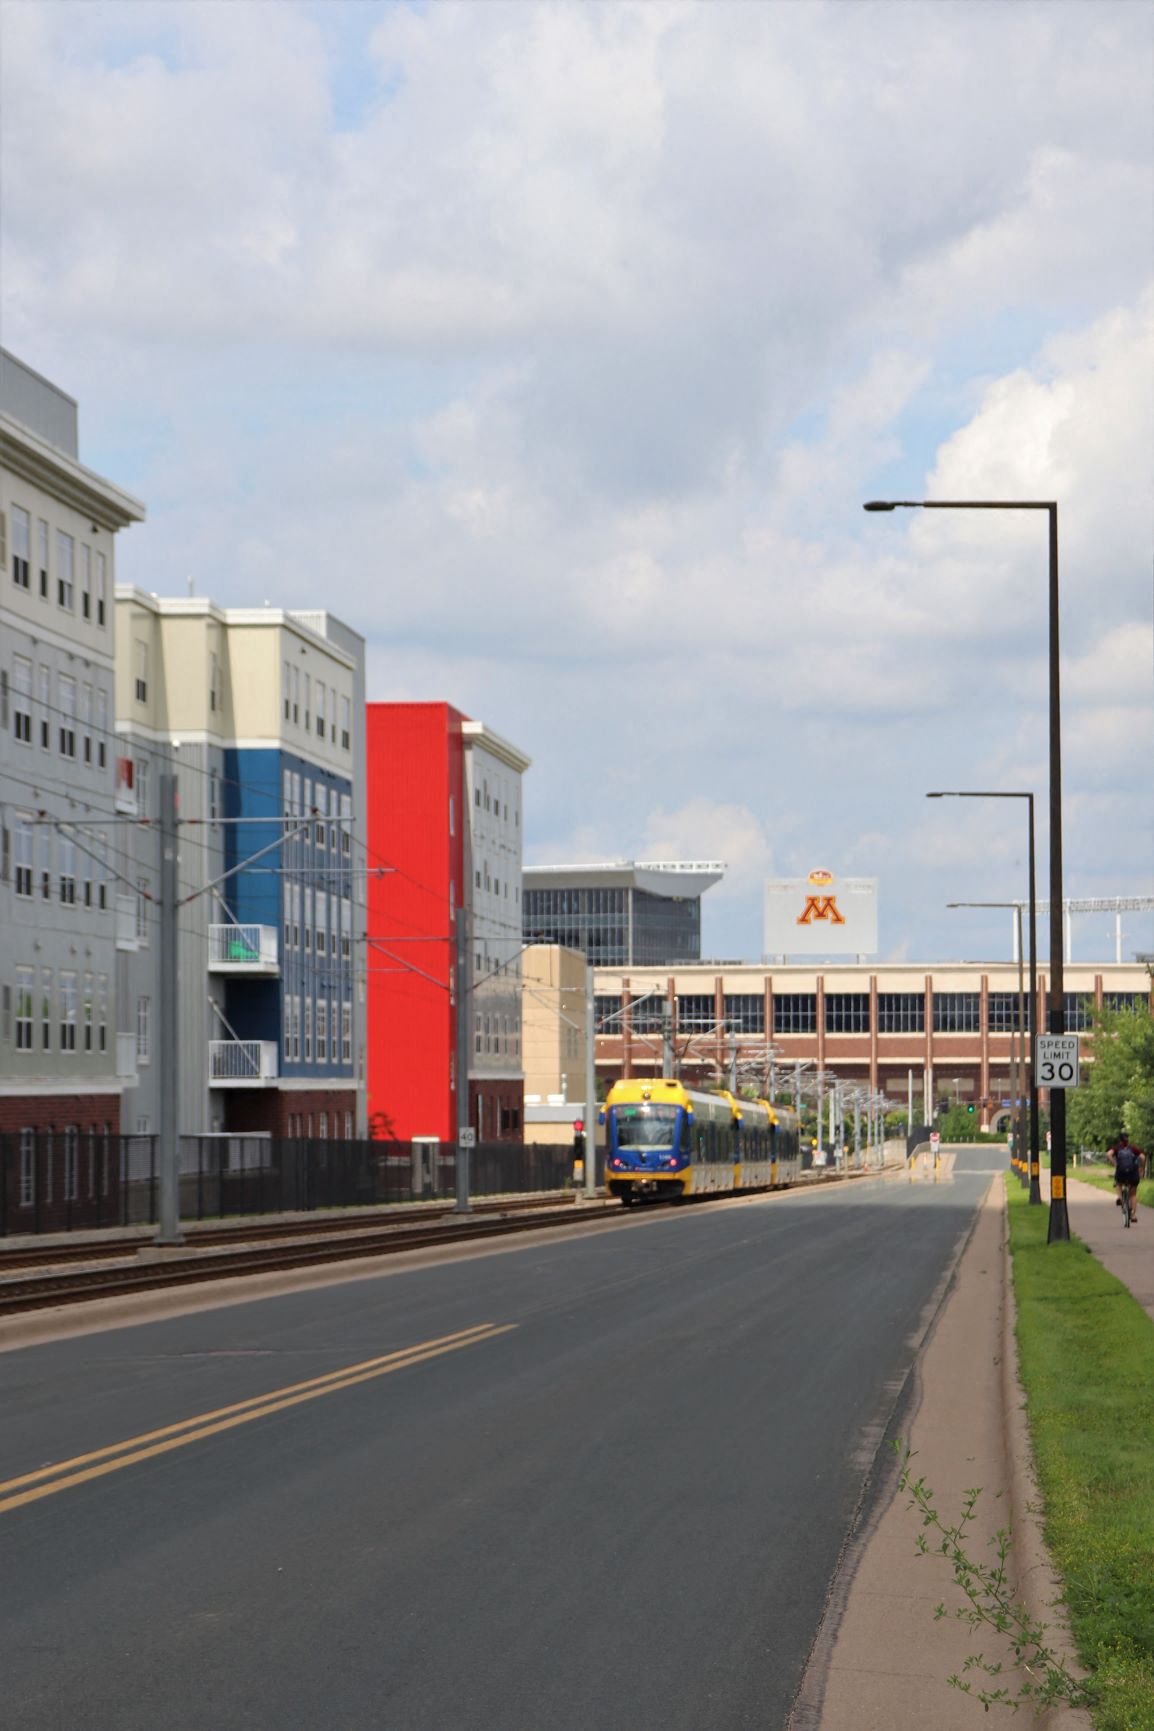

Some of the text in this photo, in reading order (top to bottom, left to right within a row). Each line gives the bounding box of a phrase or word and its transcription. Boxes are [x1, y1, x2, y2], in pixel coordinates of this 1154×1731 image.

[796, 895, 845, 925] M
[1040, 1040, 1075, 1049] SPEED
[1043, 1051, 1070, 1060] LIMIT
[1041, 1062, 1074, 1081] 30
